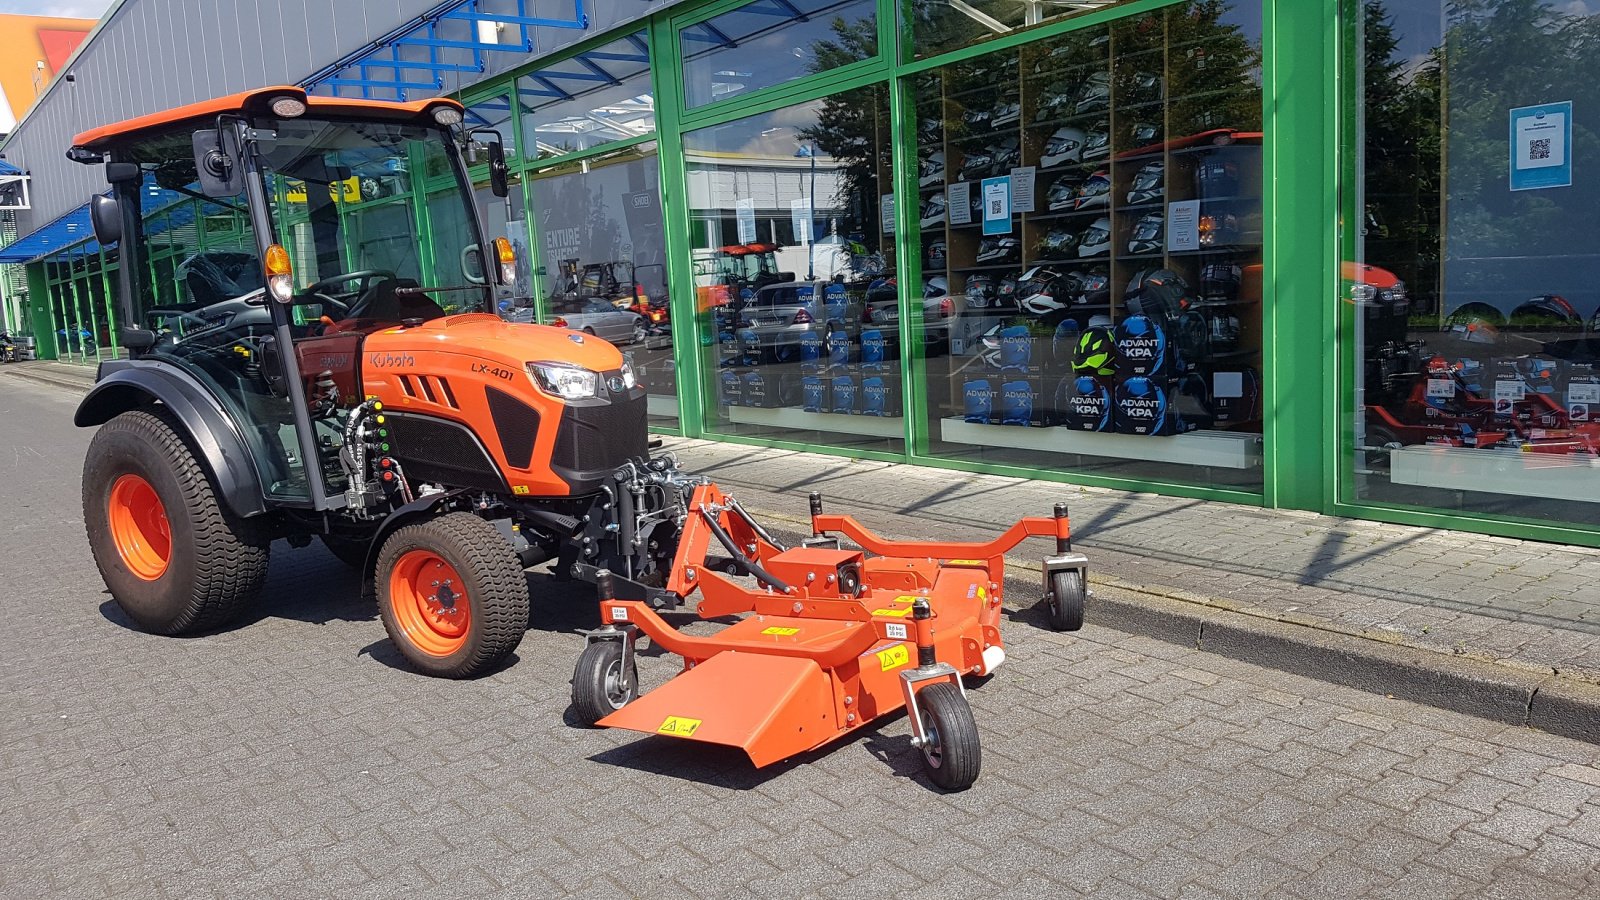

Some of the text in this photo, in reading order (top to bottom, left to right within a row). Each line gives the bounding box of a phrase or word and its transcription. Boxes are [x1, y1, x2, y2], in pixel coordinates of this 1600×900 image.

[546, 227, 581, 248] ENTURE
[1119, 339, 1160, 348] ADVANT
[1017, 344, 1025, 352] X
[1126, 348, 1152, 357] KPA
[370, 352, 415, 368] Kubota
[471, 363, 514, 381] LX-401
[864, 386, 890, 394] ADVANT
[966, 390, 998, 398] ADVANT
[843, 391, 849, 399] X
[1004, 391, 1039, 399] ADVANT
[979, 397, 986, 405] X
[1018, 399, 1026, 407] X
[1070, 397, 1105, 405] ADVANT
[1120, 399, 1160, 408] ADVANT
[1076, 405, 1099, 415] KPA
[1127, 408, 1153, 417] KPA
